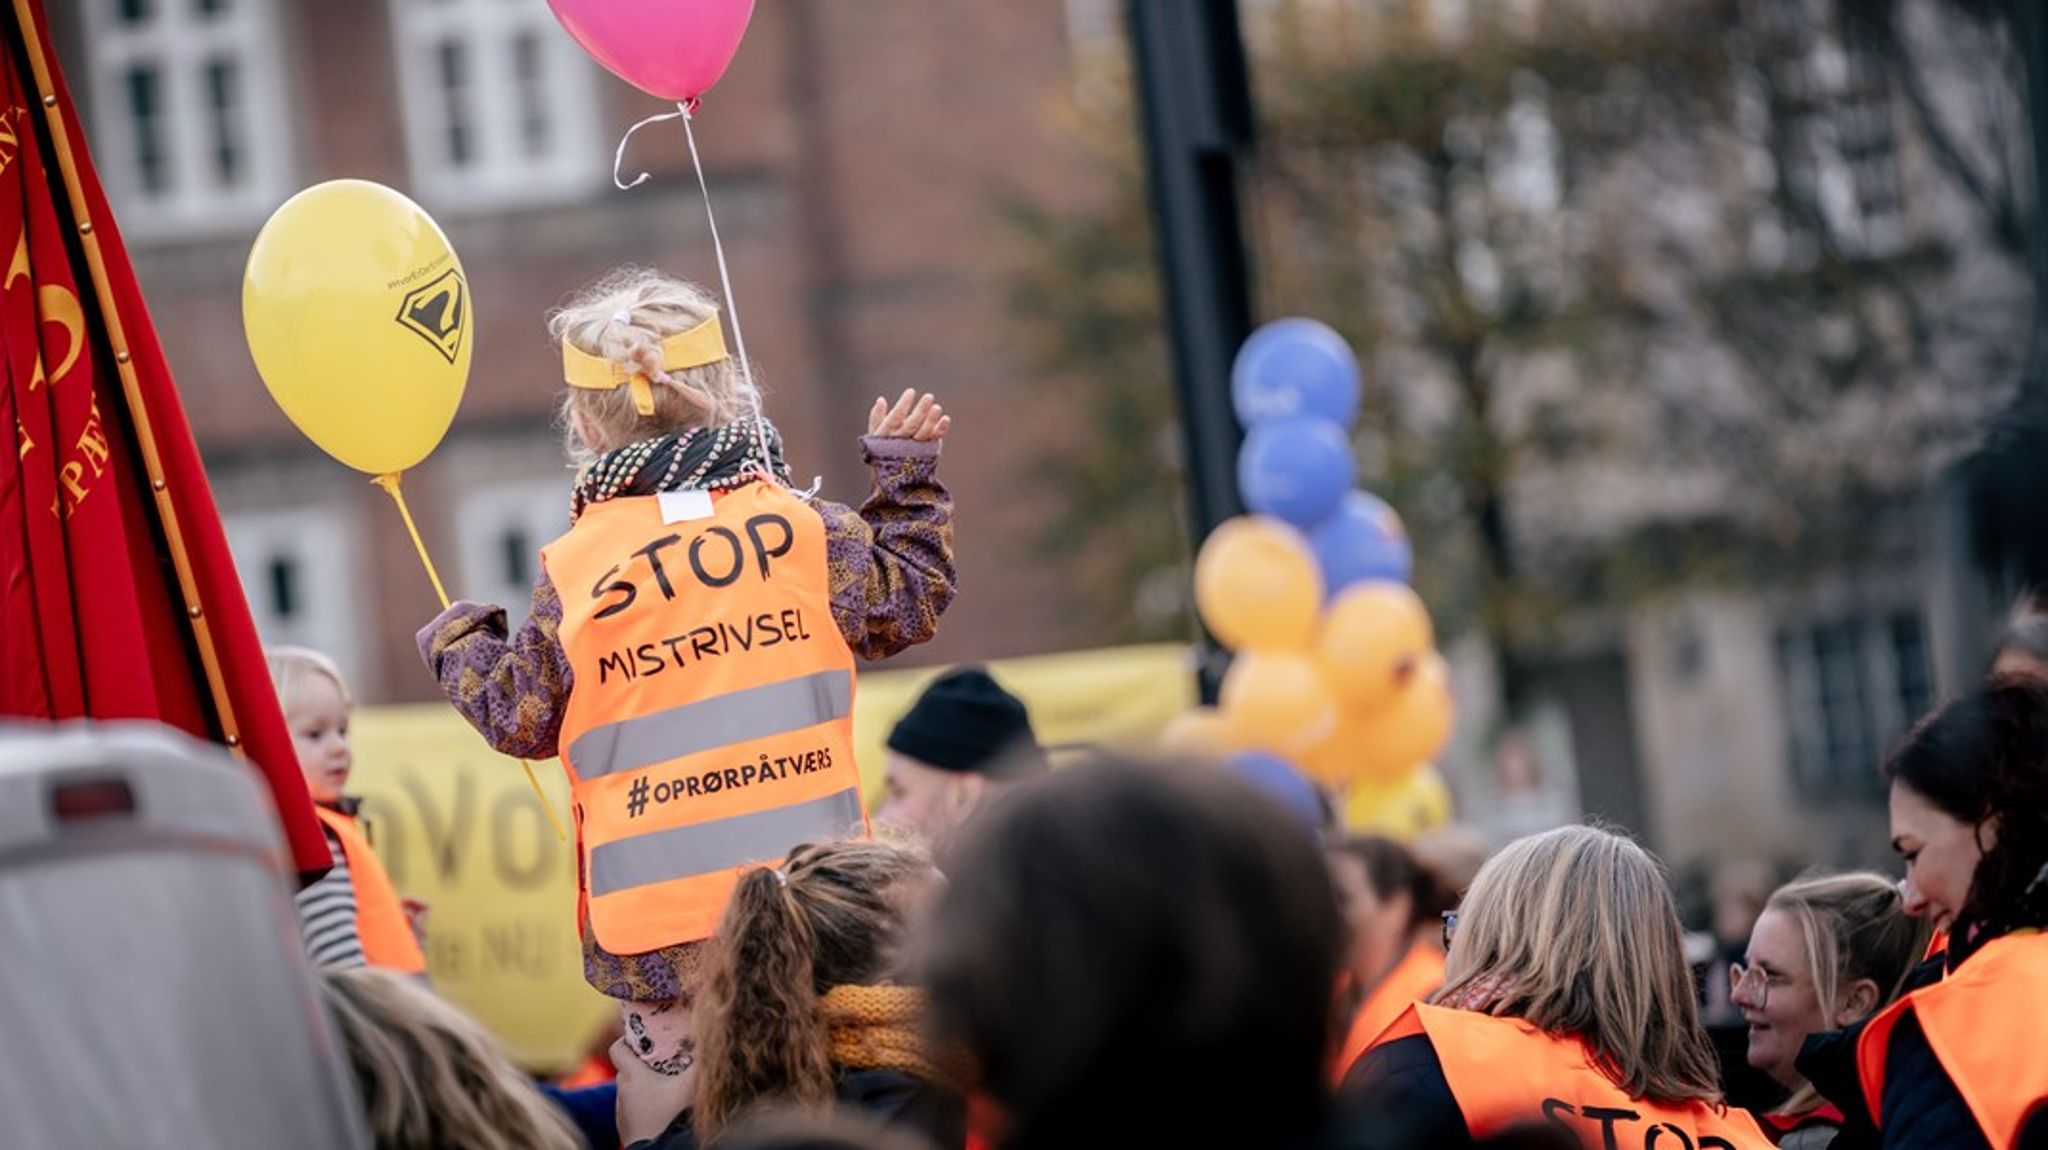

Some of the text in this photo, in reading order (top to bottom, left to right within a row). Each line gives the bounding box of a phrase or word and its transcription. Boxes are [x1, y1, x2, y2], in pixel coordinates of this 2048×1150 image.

[591, 513, 793, 619] STOP
[599, 608, 810, 684] MISTRIVSEL
[627, 748, 832, 818] #OPRØRPÅTVÆRS
